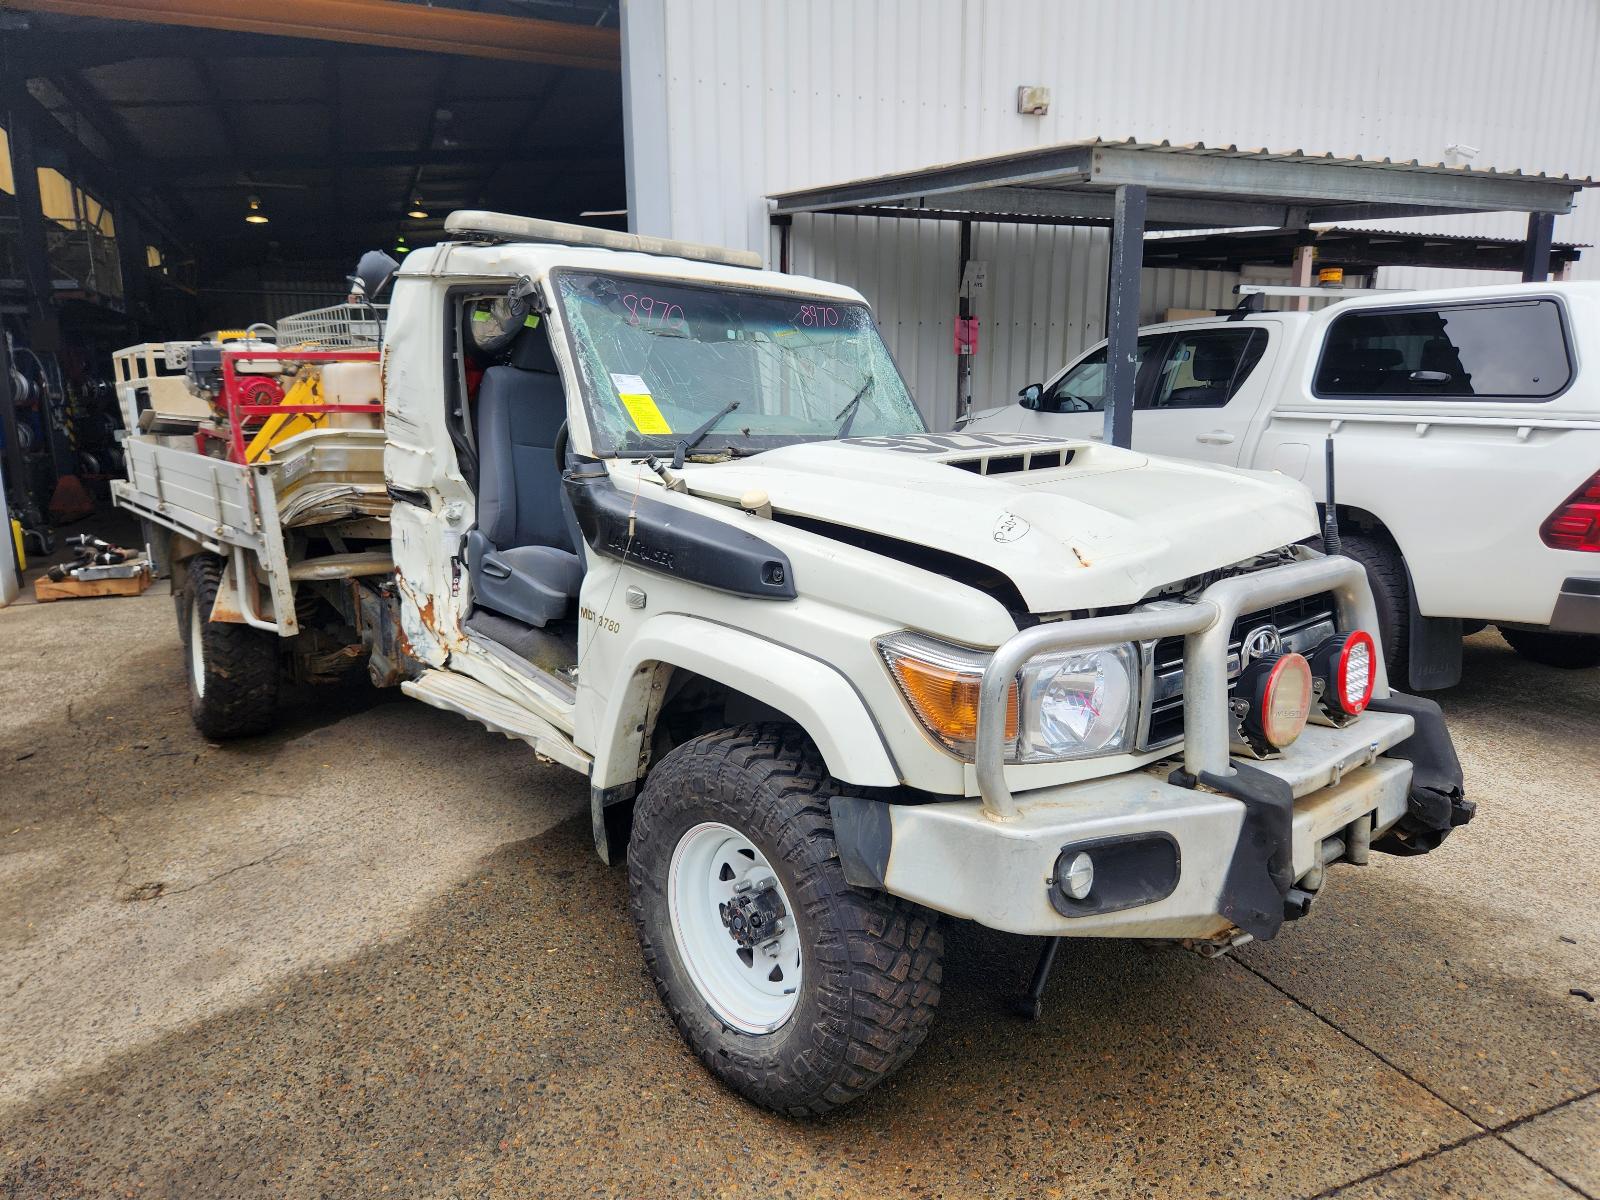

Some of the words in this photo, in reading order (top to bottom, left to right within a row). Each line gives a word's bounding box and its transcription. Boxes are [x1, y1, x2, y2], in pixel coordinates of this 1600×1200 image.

[622, 293, 685, 330] 8970
[800, 304, 839, 327] 8970
[598, 615, 620, 634] 3780
